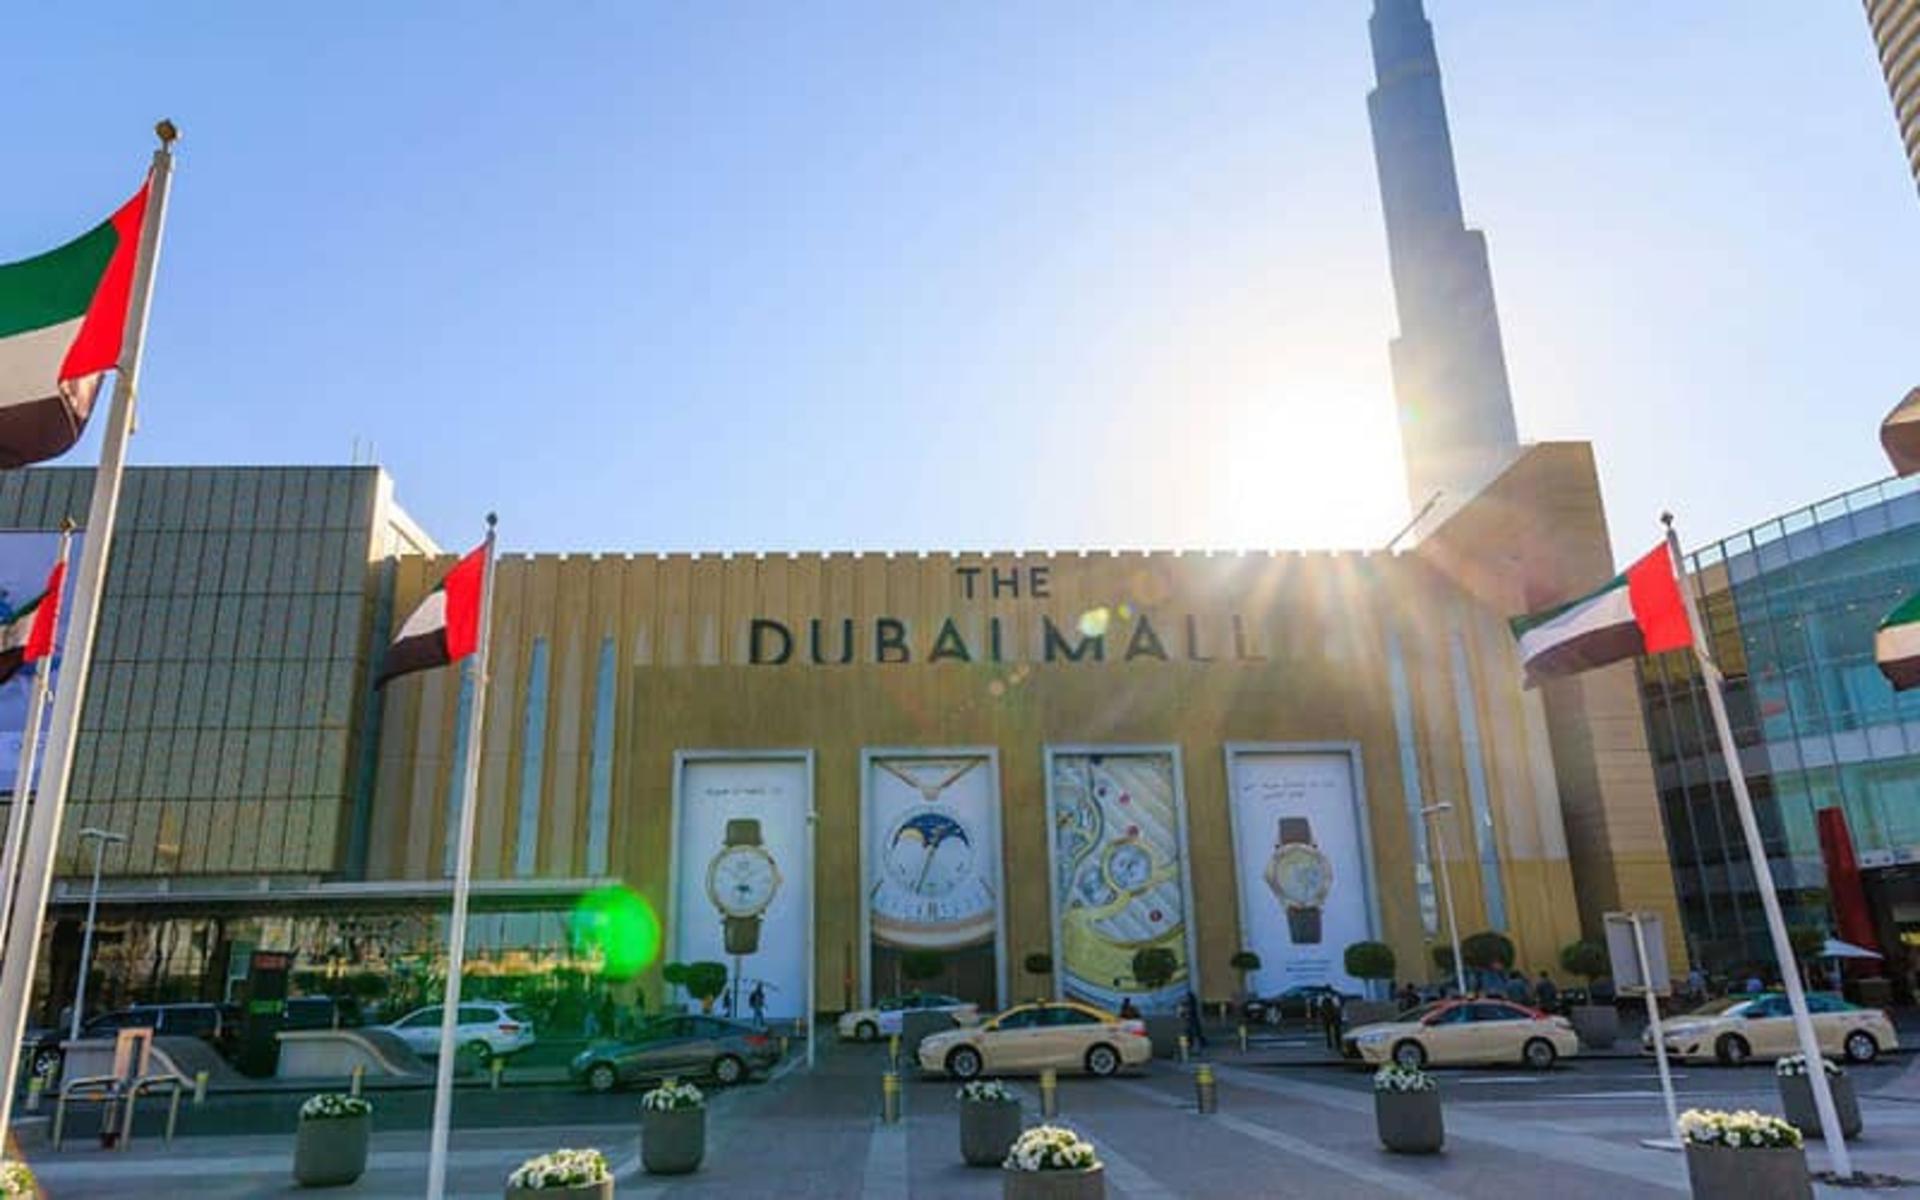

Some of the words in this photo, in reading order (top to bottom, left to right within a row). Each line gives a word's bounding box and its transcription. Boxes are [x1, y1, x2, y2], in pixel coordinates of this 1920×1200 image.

[956, 566, 1051, 599] THE
[749, 617, 1001, 665] DUBAI
[1042, 614, 1268, 663] MALL
